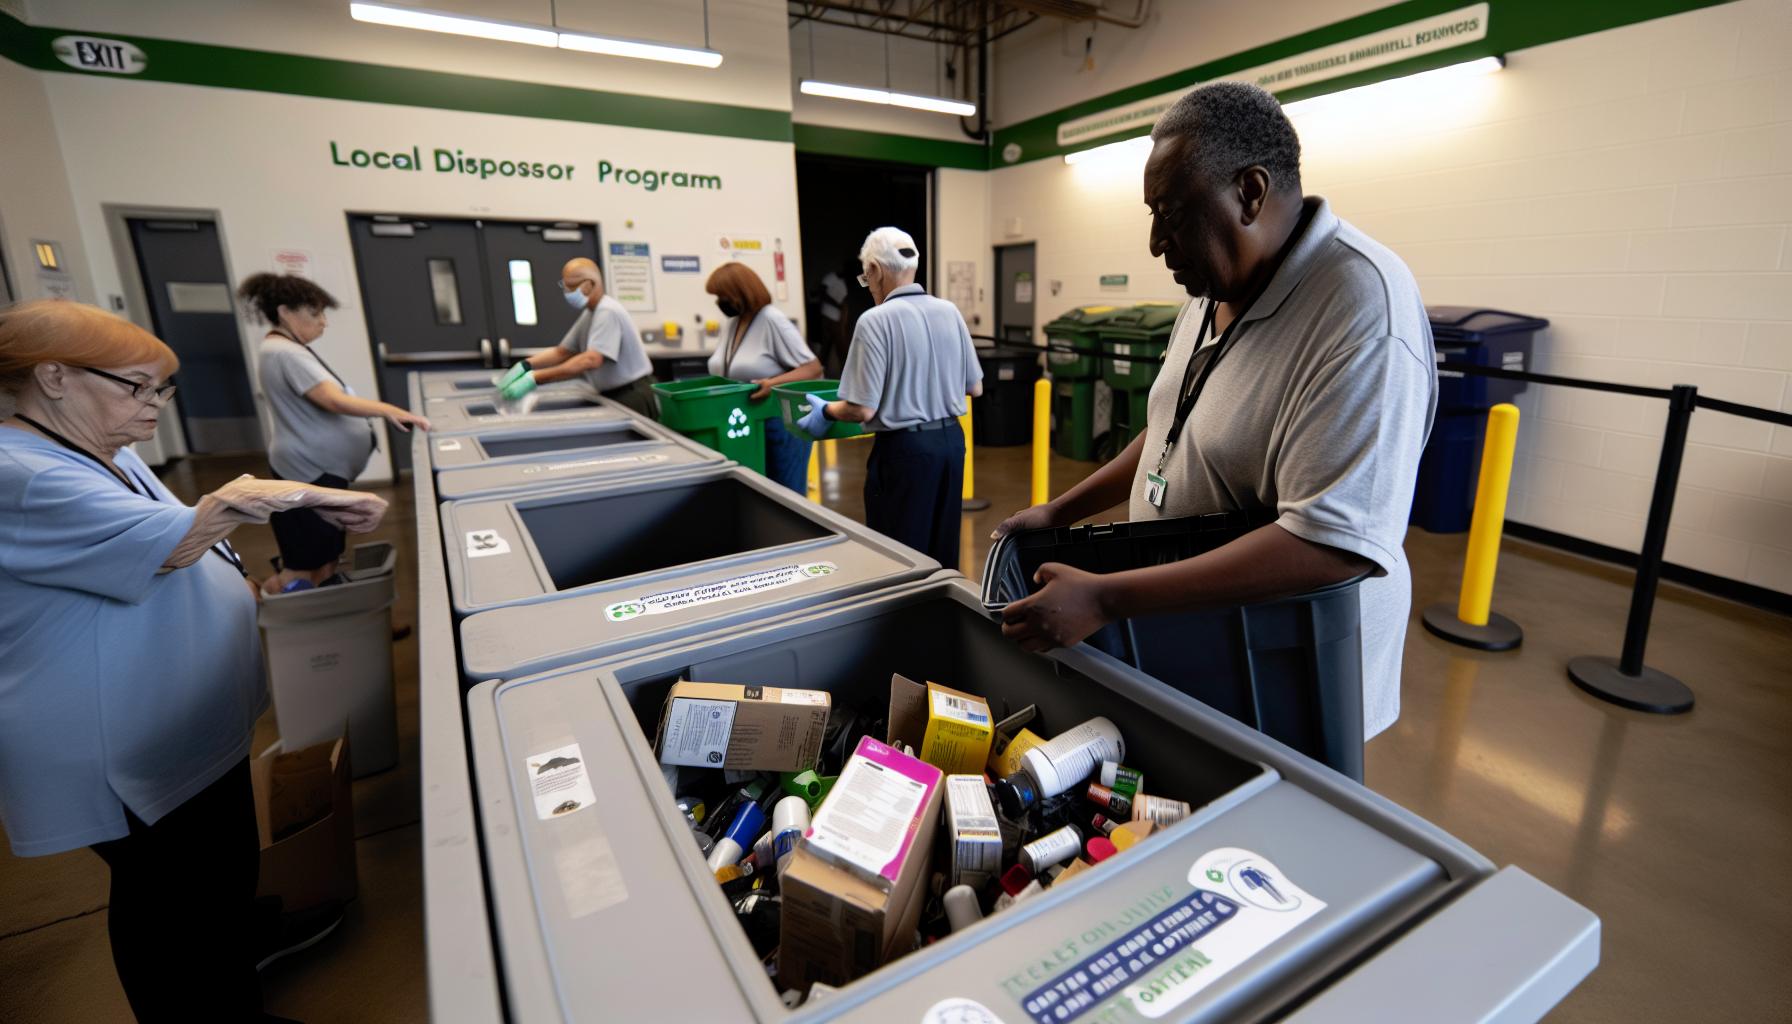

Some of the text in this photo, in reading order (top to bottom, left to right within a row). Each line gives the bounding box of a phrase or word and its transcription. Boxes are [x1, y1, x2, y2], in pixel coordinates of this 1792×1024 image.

[75, 41, 125, 70] EXIT
[329, 140, 421, 171] Local
[433, 148, 575, 180] Dispossor
